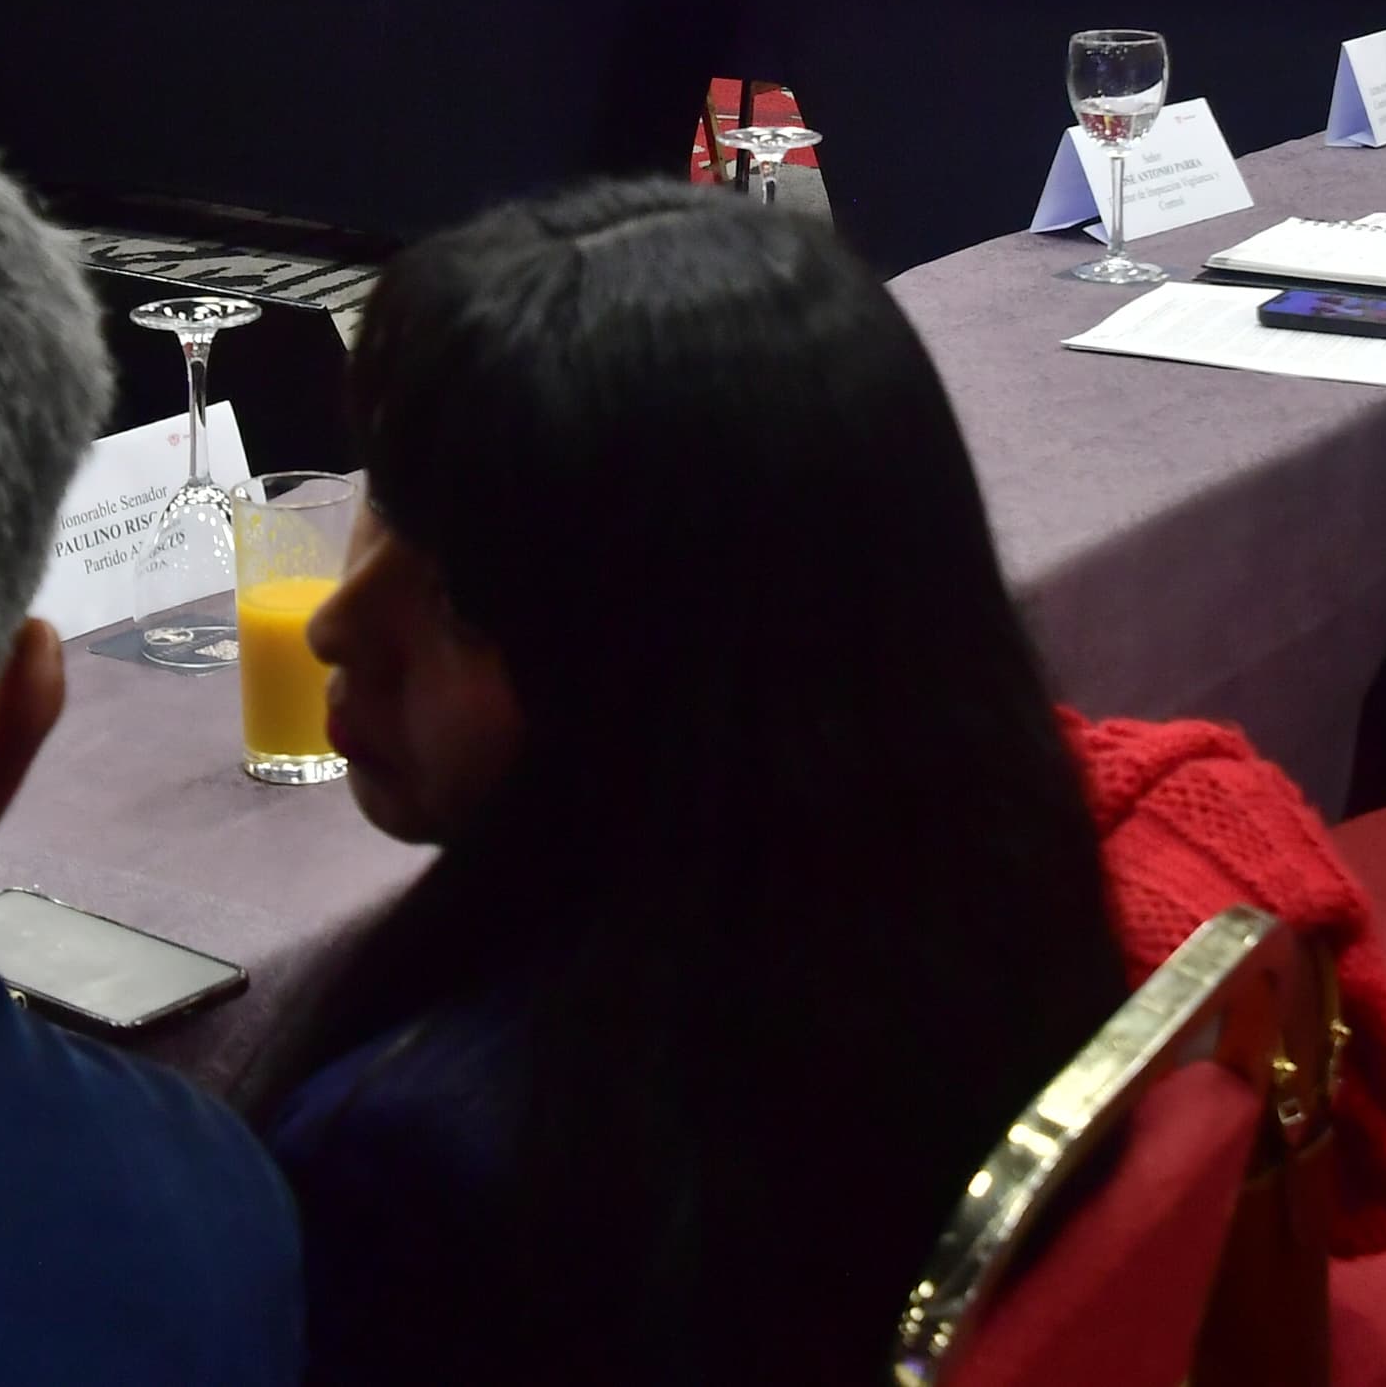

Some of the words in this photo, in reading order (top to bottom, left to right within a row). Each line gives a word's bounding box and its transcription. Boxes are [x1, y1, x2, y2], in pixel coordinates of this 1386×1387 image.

[1175, 157, 1204, 174] PARRA
[119, 485, 168, 512] Senador
[54, 523, 122, 558] PAULINO
[84, 547, 128, 575] Partido
